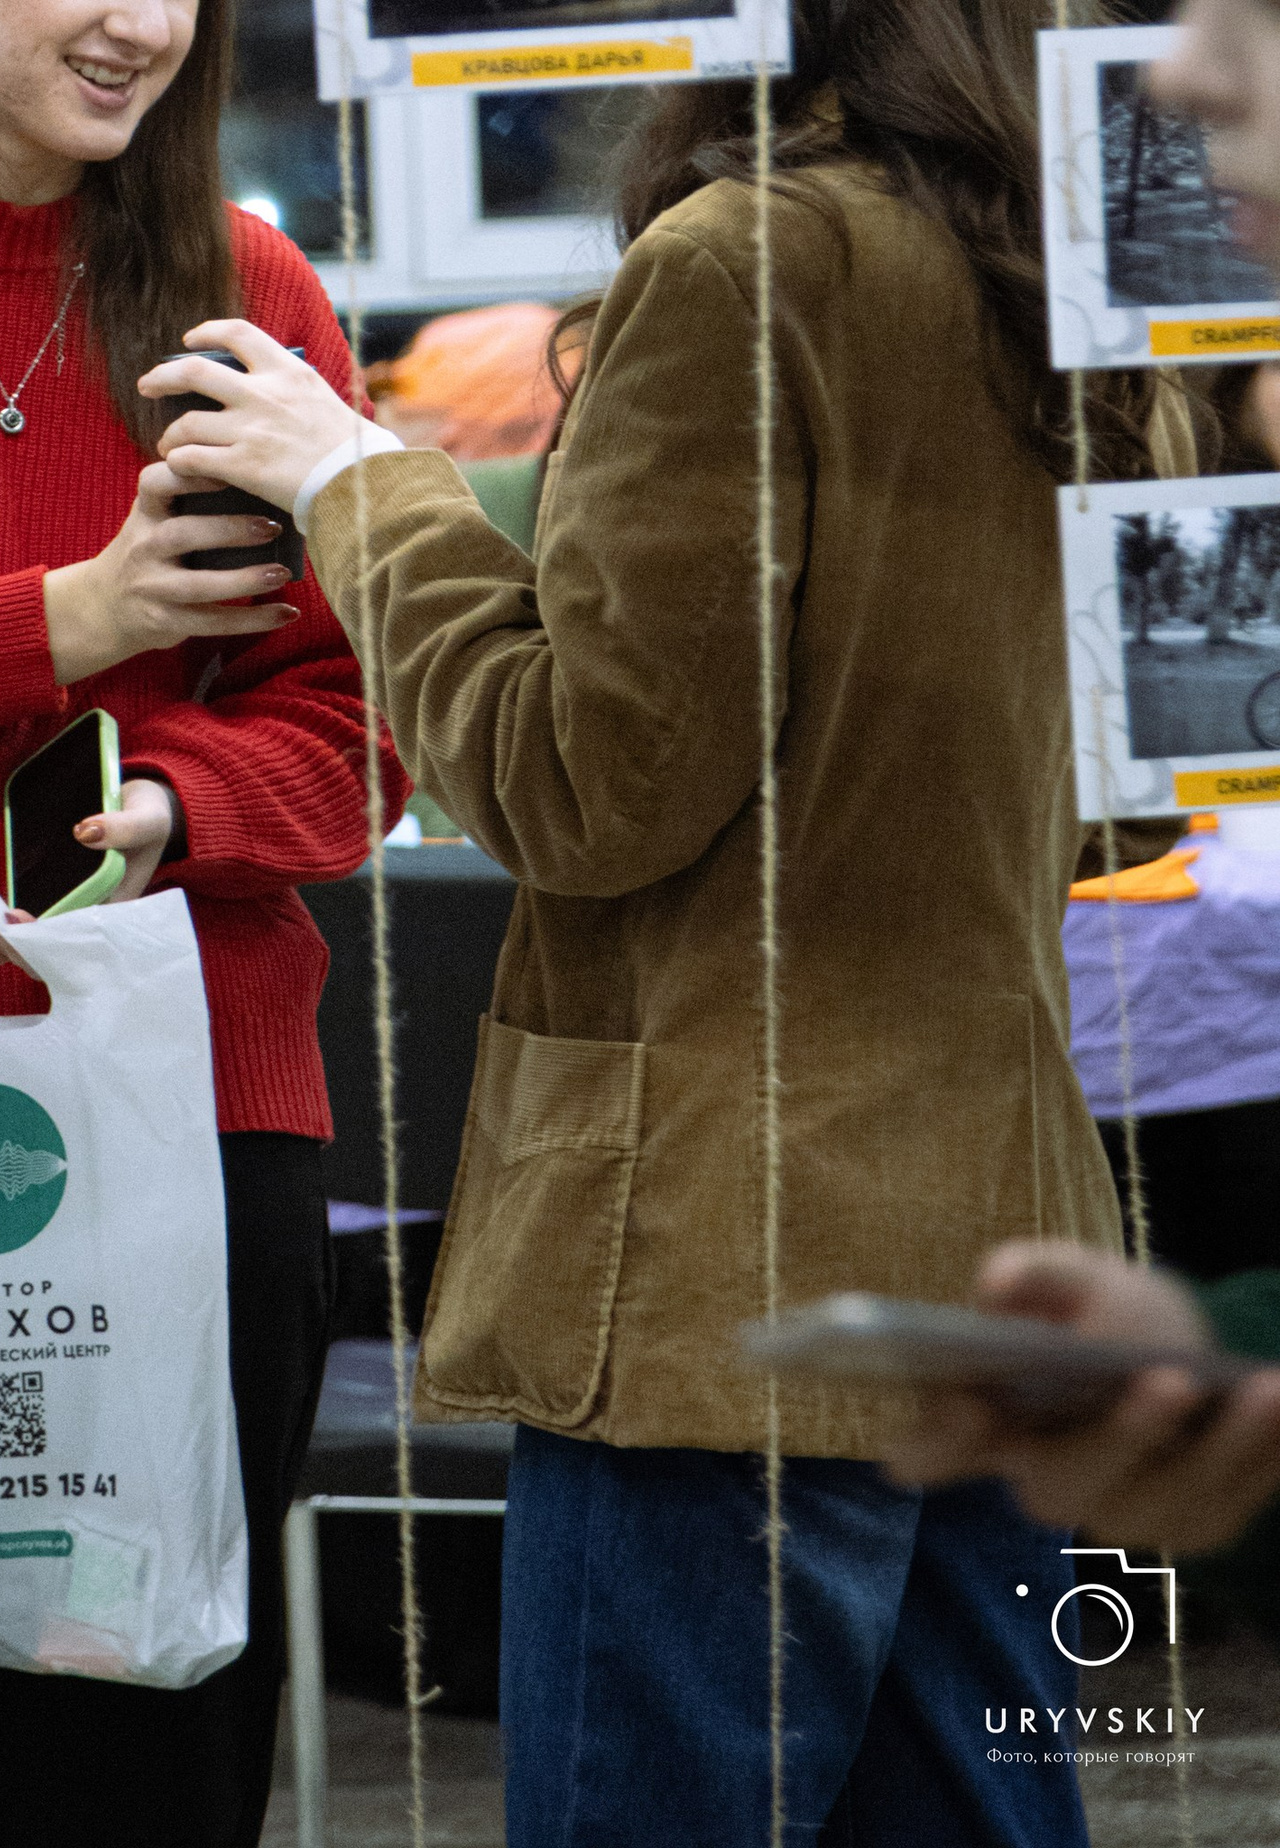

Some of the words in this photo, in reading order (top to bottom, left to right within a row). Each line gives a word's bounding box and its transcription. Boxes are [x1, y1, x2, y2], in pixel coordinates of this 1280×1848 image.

[461, 56, 569, 77] КРАВЦОВА
[575, 50, 645, 71] ДАРЬЯ
[63, 1344, 111, 1359] ЦЕНТР
[0, 1474, 48, 1499] 215
[58, 1473, 85, 1496] 15
[93, 1474, 117, 1497] 41
